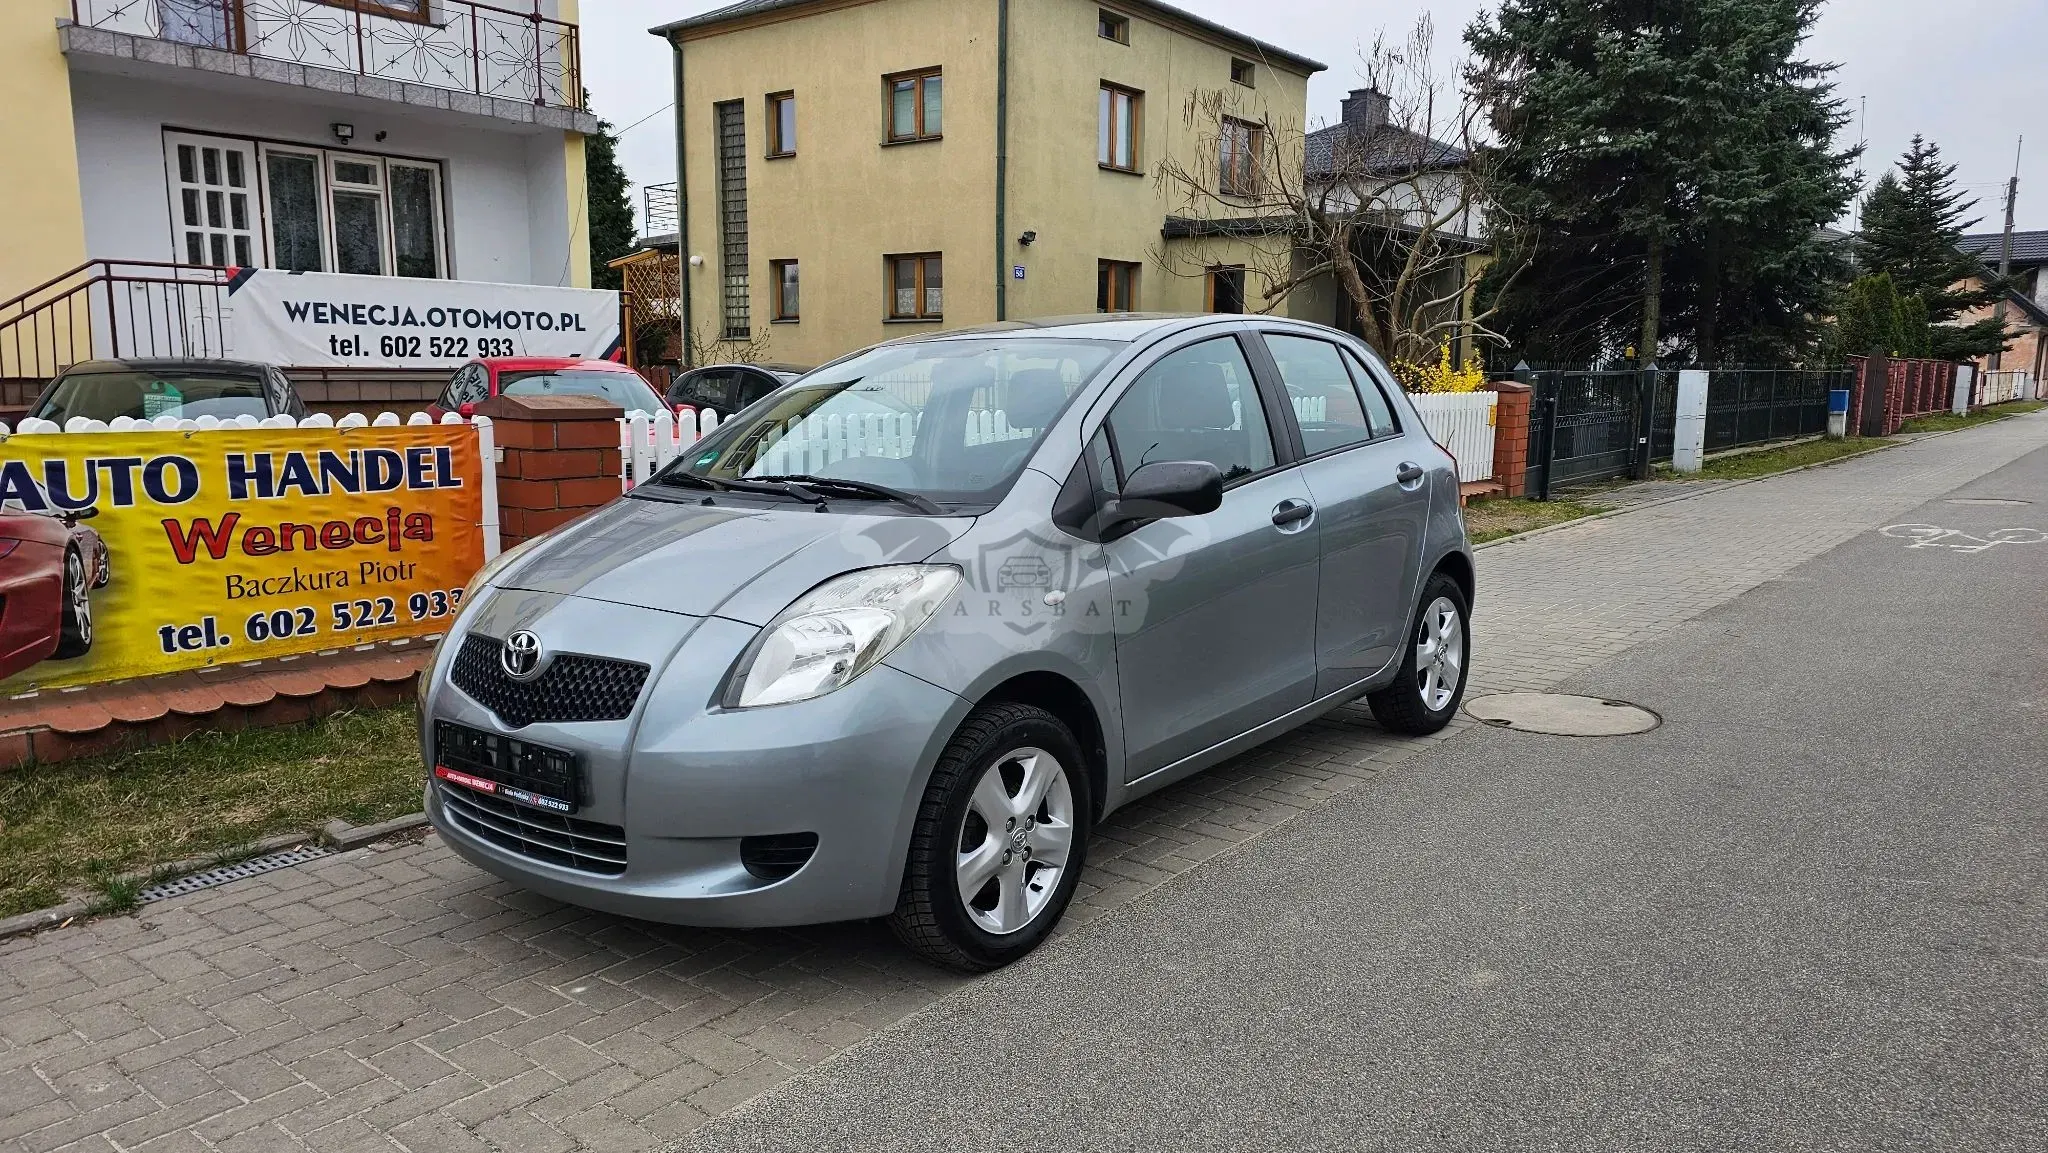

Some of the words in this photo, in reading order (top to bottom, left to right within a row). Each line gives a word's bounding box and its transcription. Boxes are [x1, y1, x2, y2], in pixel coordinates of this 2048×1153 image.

[282, 301, 586, 332] WENECJA.OTOMOTO.PL
[329, 334, 369, 357] tel.
[380, 336, 422, 358] 602
[430, 337, 469, 358] 522
[477, 338, 514, 358] 933
[0, 456, 200, 512] AUTO
[226, 447, 463, 500] HANDEL
[162, 507, 434, 565] Wenecja
[226, 567, 349, 600] Baczkura
[359, 560, 417, 585] Piotr
[159, 616, 230, 653] tel.
[246, 607, 317, 643] 602
[332, 598, 396, 632] 522
[548, 800, 559, 809] 522
[559, 803, 569, 811] 933
